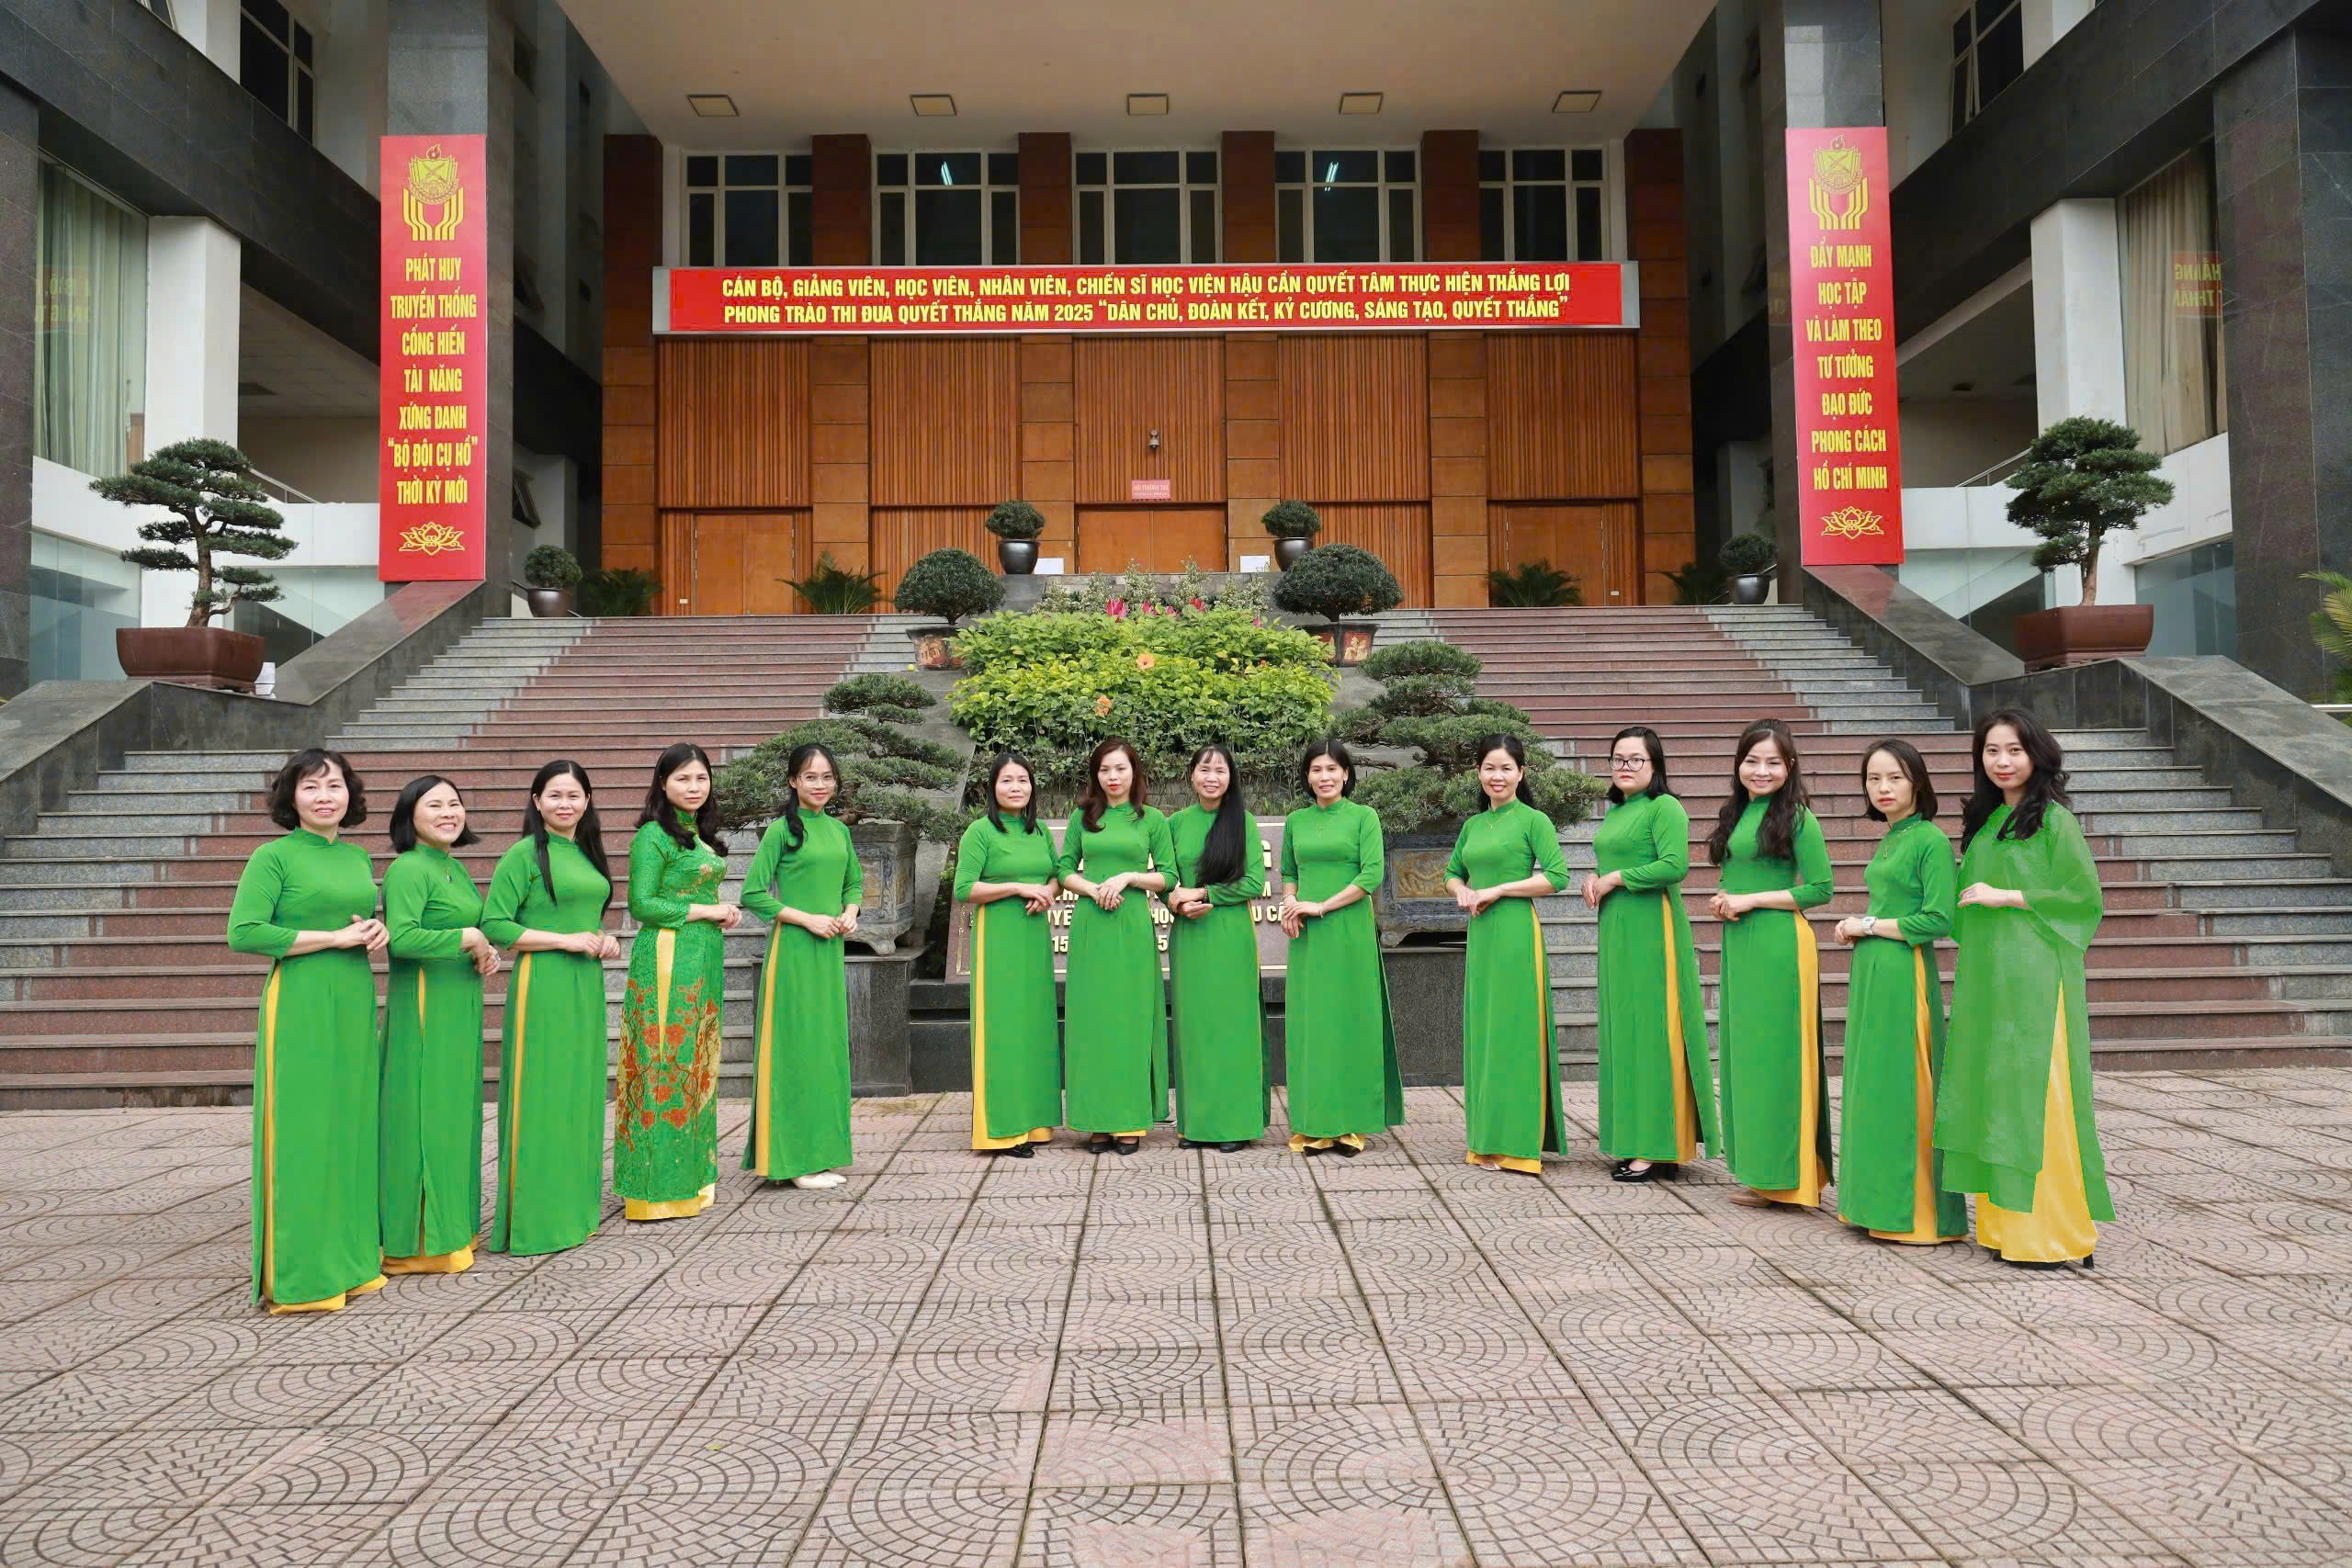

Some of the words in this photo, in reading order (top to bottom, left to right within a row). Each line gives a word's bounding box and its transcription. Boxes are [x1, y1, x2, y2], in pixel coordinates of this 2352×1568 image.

[405, 253, 436, 282] PHÁT
[438, 257, 462, 281] HUY
[1810, 236, 1834, 268] ĐẨY
[1836, 245, 1872, 273] MẠNH
[722, 276, 756, 297] CÁN
[761, 276, 788, 300] BỘ,
[793, 274, 843, 297] GIẢNG
[847, 276, 890, 299] VIÊN,
[895, 278, 928, 299] HỌC
[932, 276, 975, 298] VIÊN,
[978, 275, 1025, 296] NHÂN
[1029, 275, 1072, 297] VIÊN,
[1076, 272, 1125, 295] CHIẾN
[1129, 274, 1148, 295] SĨ
[1151, 276, 1183, 299] HỌC
[1188, 273, 1226, 298] VIỆN
[1230, 273, 1262, 297] HẬU
[1267, 269, 1301, 293] CẦN
[1306, 270, 1356, 294] QUYẾT
[1360, 271, 1395, 292] TÂM
[1398, 274, 1441, 296] THỰC
[1444, 271, 1483, 295] HIỆN
[1487, 268, 1541, 291] THẮNG
[1544, 273, 1570, 294] LỢI
[1817, 282, 1842, 310] HỌC
[1844, 278, 1868, 310] TẬP
[390, 287, 435, 319] TRUYỀN
[437, 286, 478, 318] THỐNG
[724, 306, 780, 323] PHONG
[785, 302, 827, 323] TRÀO
[831, 305, 857, 322] THI
[861, 305, 894, 322] ĐUA
[898, 299, 949, 324] QUYẾT
[952, 299, 1007, 322] THẮNG
[1011, 301, 1049, 321] NĂM
[1054, 304, 1093, 321] 2025
[1146, 298, 1183, 322] CHỦ,
[1188, 299, 1233, 320] ĐOÀN
[1238, 297, 1270, 321] KẾT,
[1273, 297, 1295, 320] KỶ
[1299, 299, 1360, 321] CƯƠNG,
[1363, 299, 1408, 319] SÁNG
[1412, 301, 1447, 321] TẠO,
[1452, 296, 1502, 319] QUYẾT
[401, 323, 435, 355] CỐNG
[437, 323, 466, 355] HIẾN
[1805, 315, 1823, 342] VÀ
[1824, 315, 1850, 342] LÀM
[1852, 318, 1883, 342] THEO
[404, 365, 423, 393] TÀI
[428, 364, 463, 392] NĂNG
[1816, 354, 1835, 378] TƯ
[1834, 348, 1874, 378] TƯỞNG
[399, 401, 432, 430] XỨNG
[434, 405, 468, 430] DANH
[1822, 392, 1846, 421] ĐẠO
[1849, 388, 1873, 416] ĐỨC
[1811, 429, 1852, 453] PHONG
[1854, 425, 1887, 453] CÁCH
[413, 438, 434, 472] ĐỘI
[435, 443, 453, 471] CỤ
[397, 474, 424, 505] THỜI
[425, 475, 442, 504] KỲ
[444, 475, 469, 504] MỚI
[1813, 460, 1830, 491] HỒ
[1832, 462, 1853, 491] CHÍ
[1855, 467, 1888, 490] MINH
